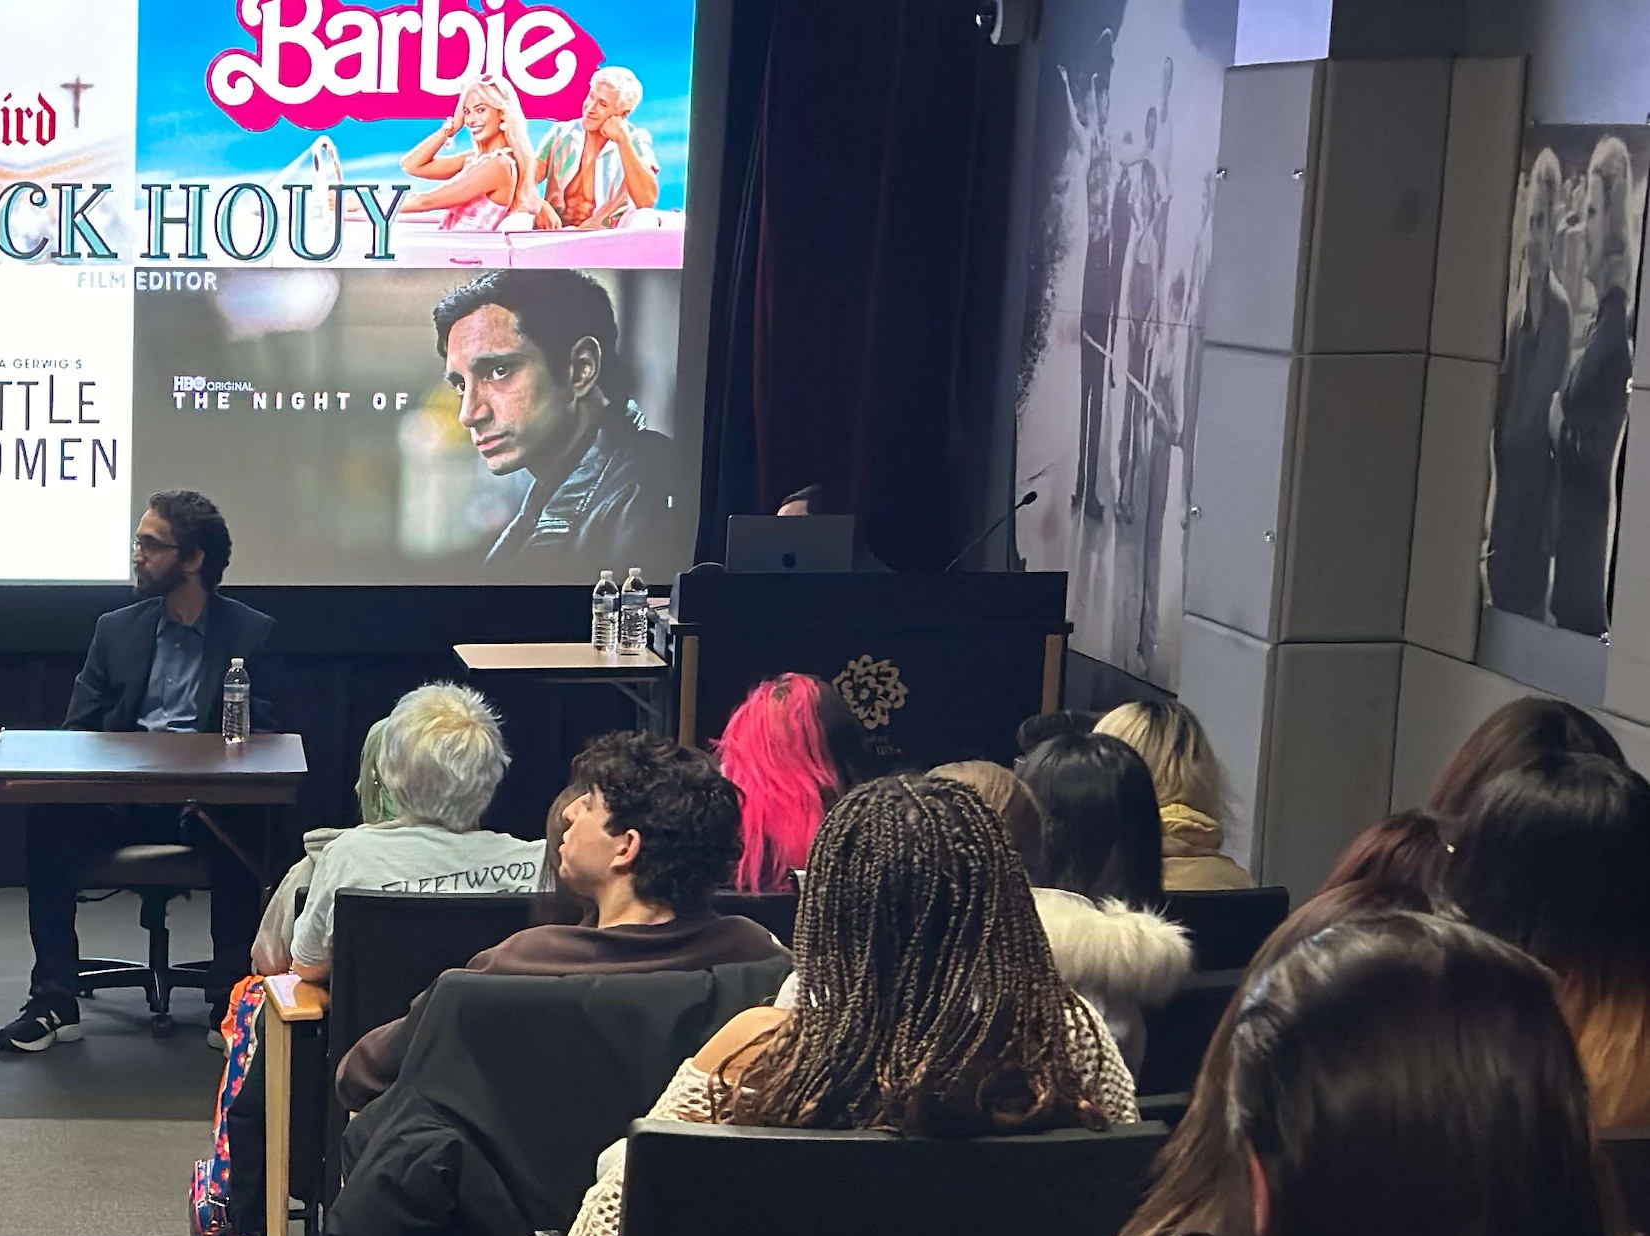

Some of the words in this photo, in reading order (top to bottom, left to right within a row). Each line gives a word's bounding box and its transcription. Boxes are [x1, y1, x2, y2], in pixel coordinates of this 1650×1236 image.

[211, 0, 576, 107] Barbie
[140, 183, 412, 262] HOUY
[77, 271, 126, 289] FILM
[135, 271, 218, 291] EDITOR
[173, 375, 206, 392] HBO
[206, 381, 254, 392] ORIGINAL
[173, 392, 230, 410] THE
[253, 392, 350, 411] NIGHT
[372, 392, 408, 411] OF
